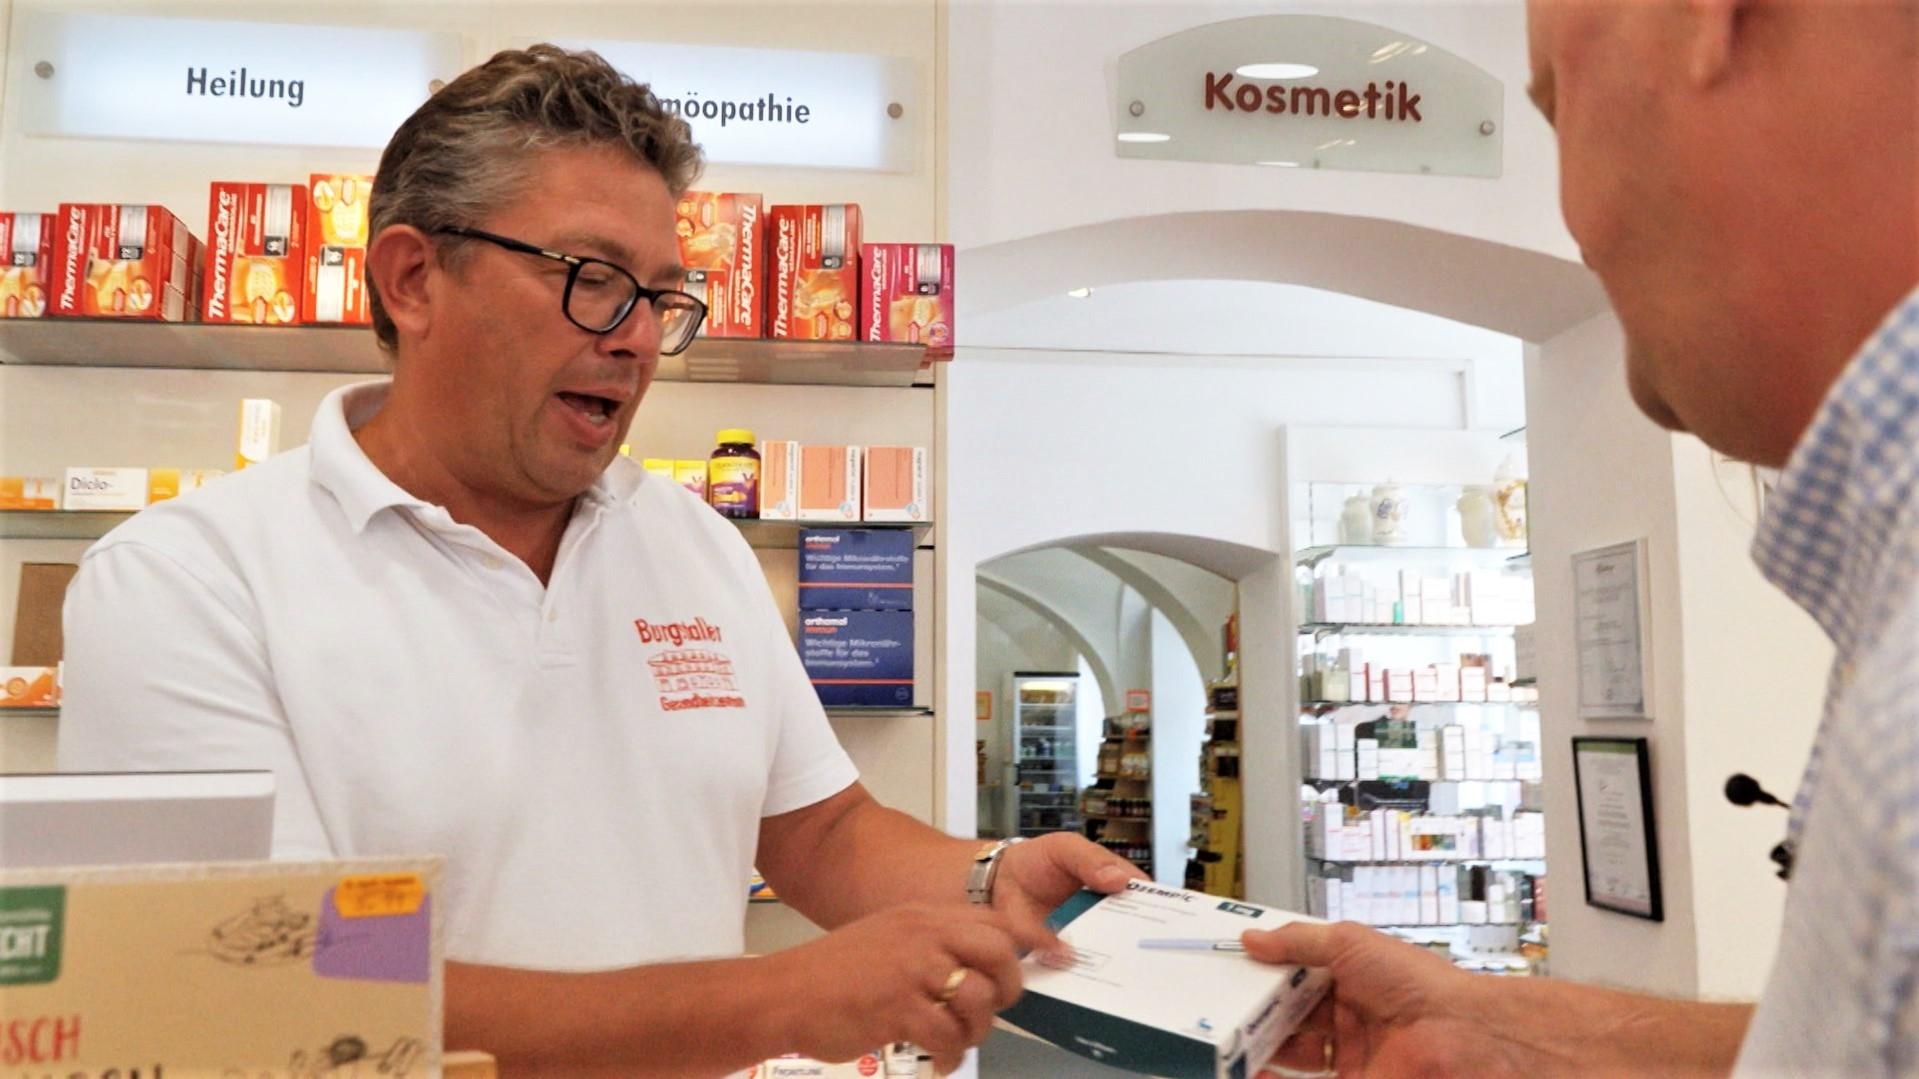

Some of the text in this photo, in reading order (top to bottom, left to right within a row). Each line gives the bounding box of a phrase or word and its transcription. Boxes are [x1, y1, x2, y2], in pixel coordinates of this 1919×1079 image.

[186, 66, 305, 108] Heilung
[658, 92, 811, 128] möopathie
[1205, 71, 1422, 123] Kosmetik
[60, 206, 83, 310] ThermaCare
[207, 189, 232, 319] ThermaCare
[740, 203, 757, 327] ThermaCare
[773, 217, 790, 338] ThermaCare
[869, 245, 882, 342] ThermaCare
[0, 1012, 82, 1067] SCH
